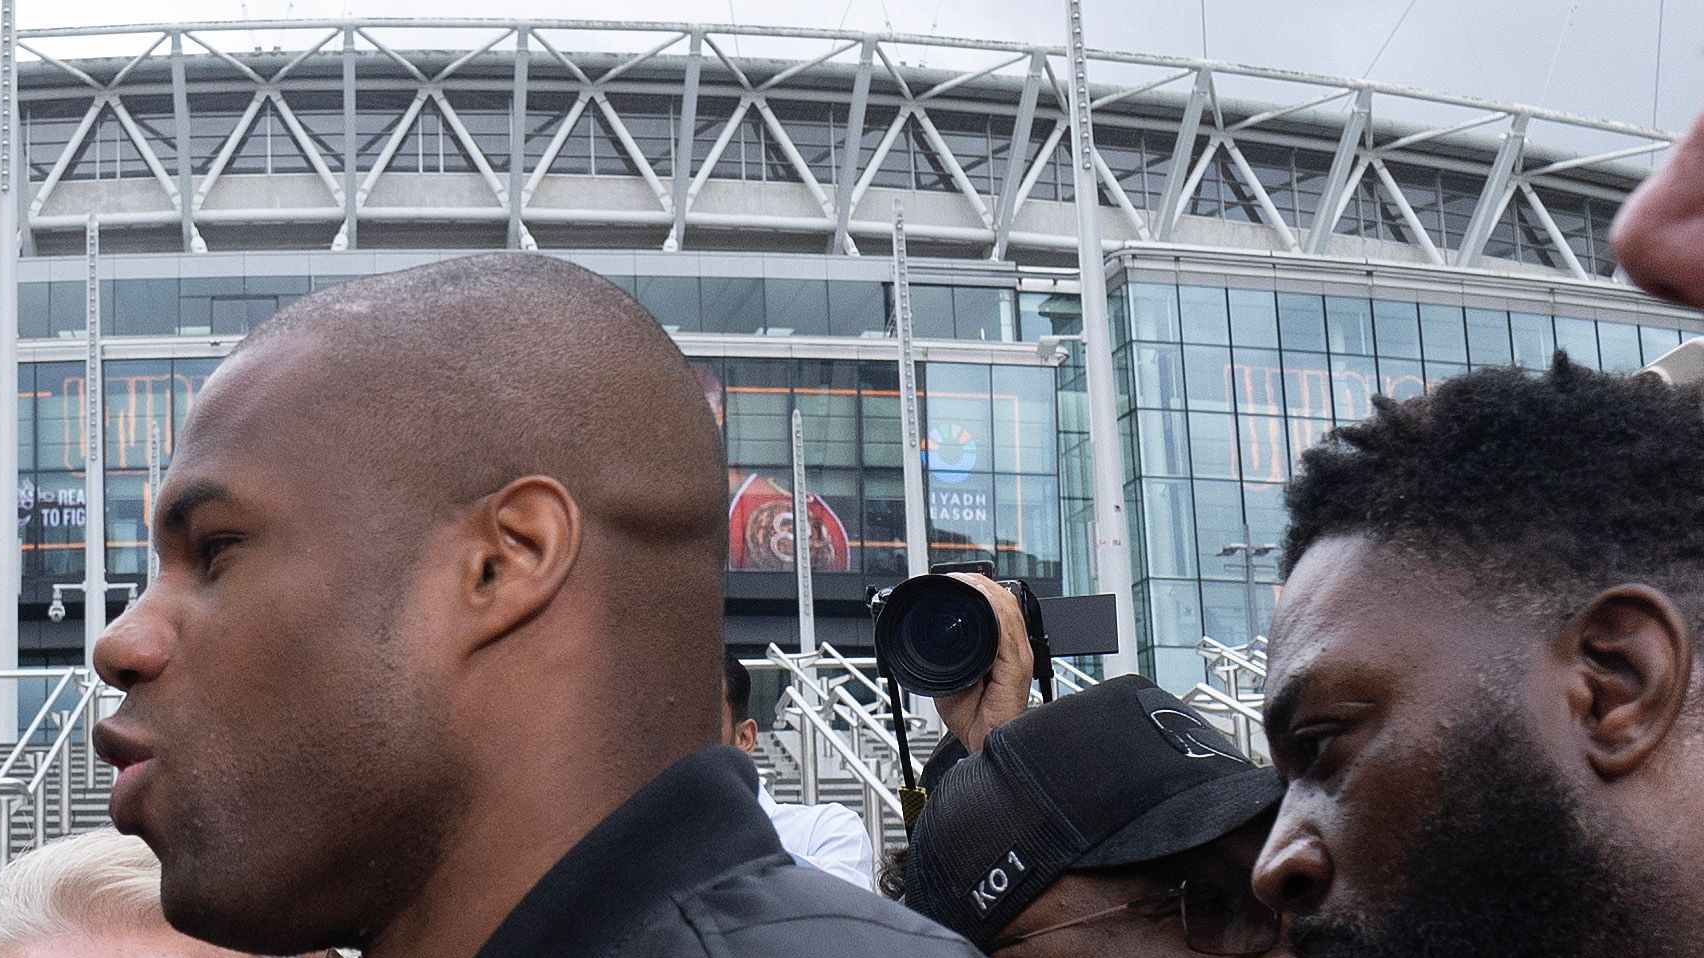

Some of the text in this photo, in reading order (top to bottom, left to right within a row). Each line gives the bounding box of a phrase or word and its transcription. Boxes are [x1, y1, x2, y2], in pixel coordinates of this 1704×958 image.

[929, 491, 987, 507] IYADH
[40, 507, 86, 527] TO FIG
[929, 506, 988, 521] EASON
